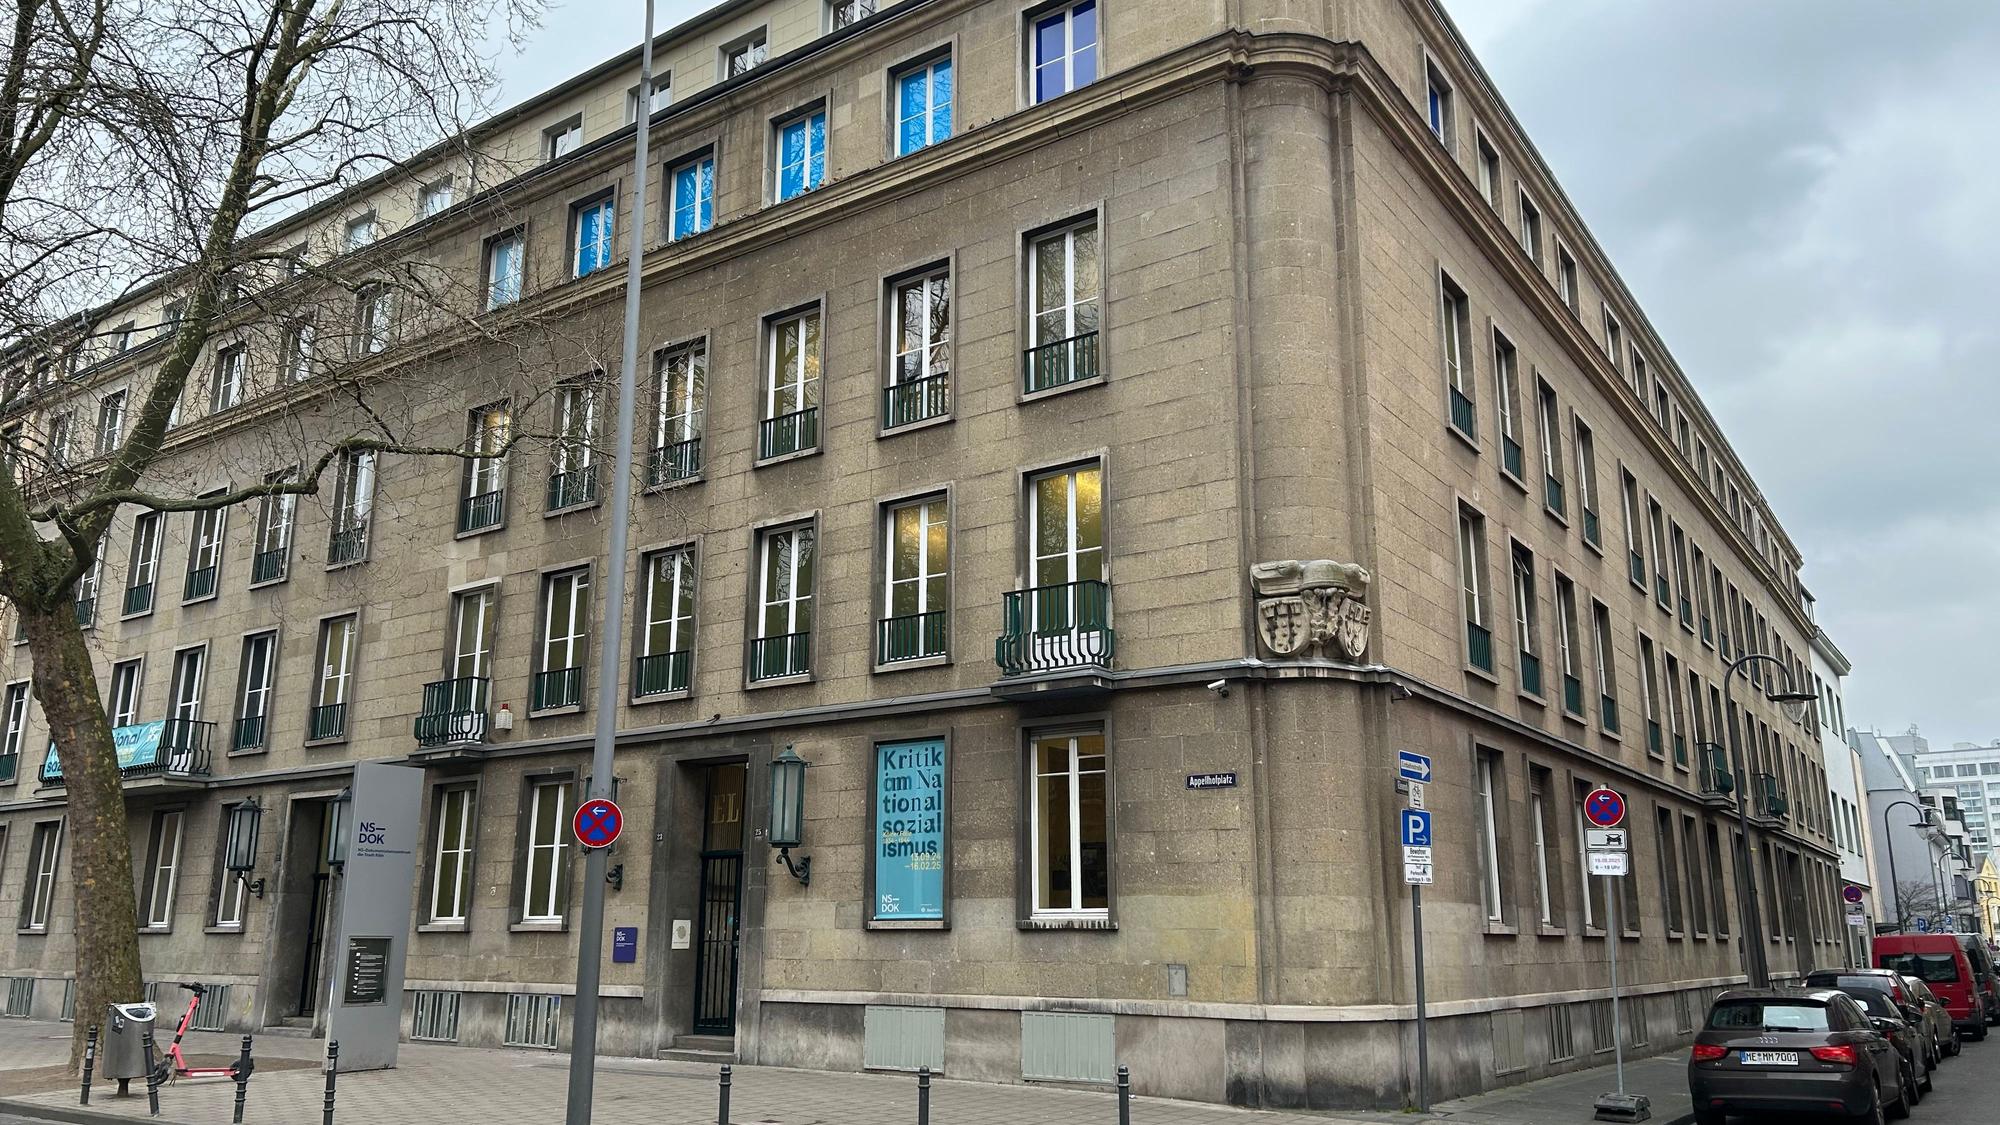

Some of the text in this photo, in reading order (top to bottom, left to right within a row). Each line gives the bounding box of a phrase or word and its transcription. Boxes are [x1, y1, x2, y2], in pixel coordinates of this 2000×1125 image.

[883, 746, 942, 770] Kritik
[916, 769, 942, 790] Na
[1189, 774, 1233, 788] Appellhofplatz
[882, 789, 942, 814] tional
[882, 811, 942, 833] sozial
[1408, 814, 1425, 844] P
[358, 833, 385, 845] DOK
[882, 838, 938, 858] ismus
[911, 852, 941, 861] 13.09.24
[881, 903, 900, 912] DOK
[1746, 1052, 1798, 1062] ME MM 7001
